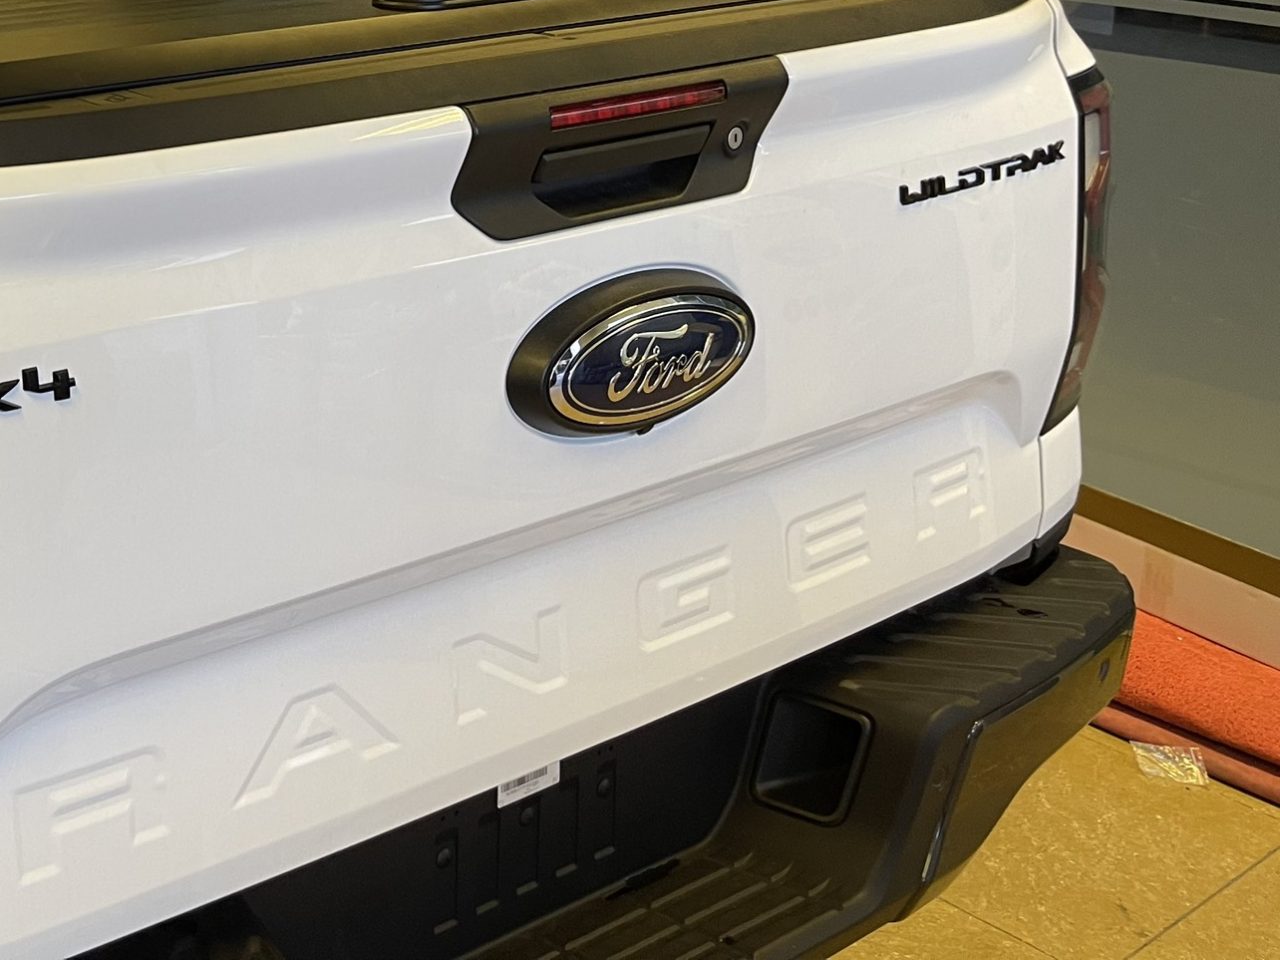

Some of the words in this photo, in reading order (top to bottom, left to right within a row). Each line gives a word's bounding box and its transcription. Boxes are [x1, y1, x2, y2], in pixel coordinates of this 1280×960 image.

[899, 139, 1065, 206] WILDTRAK
[607, 324, 715, 403] Ford
[13, 446, 987, 887] RANGER
